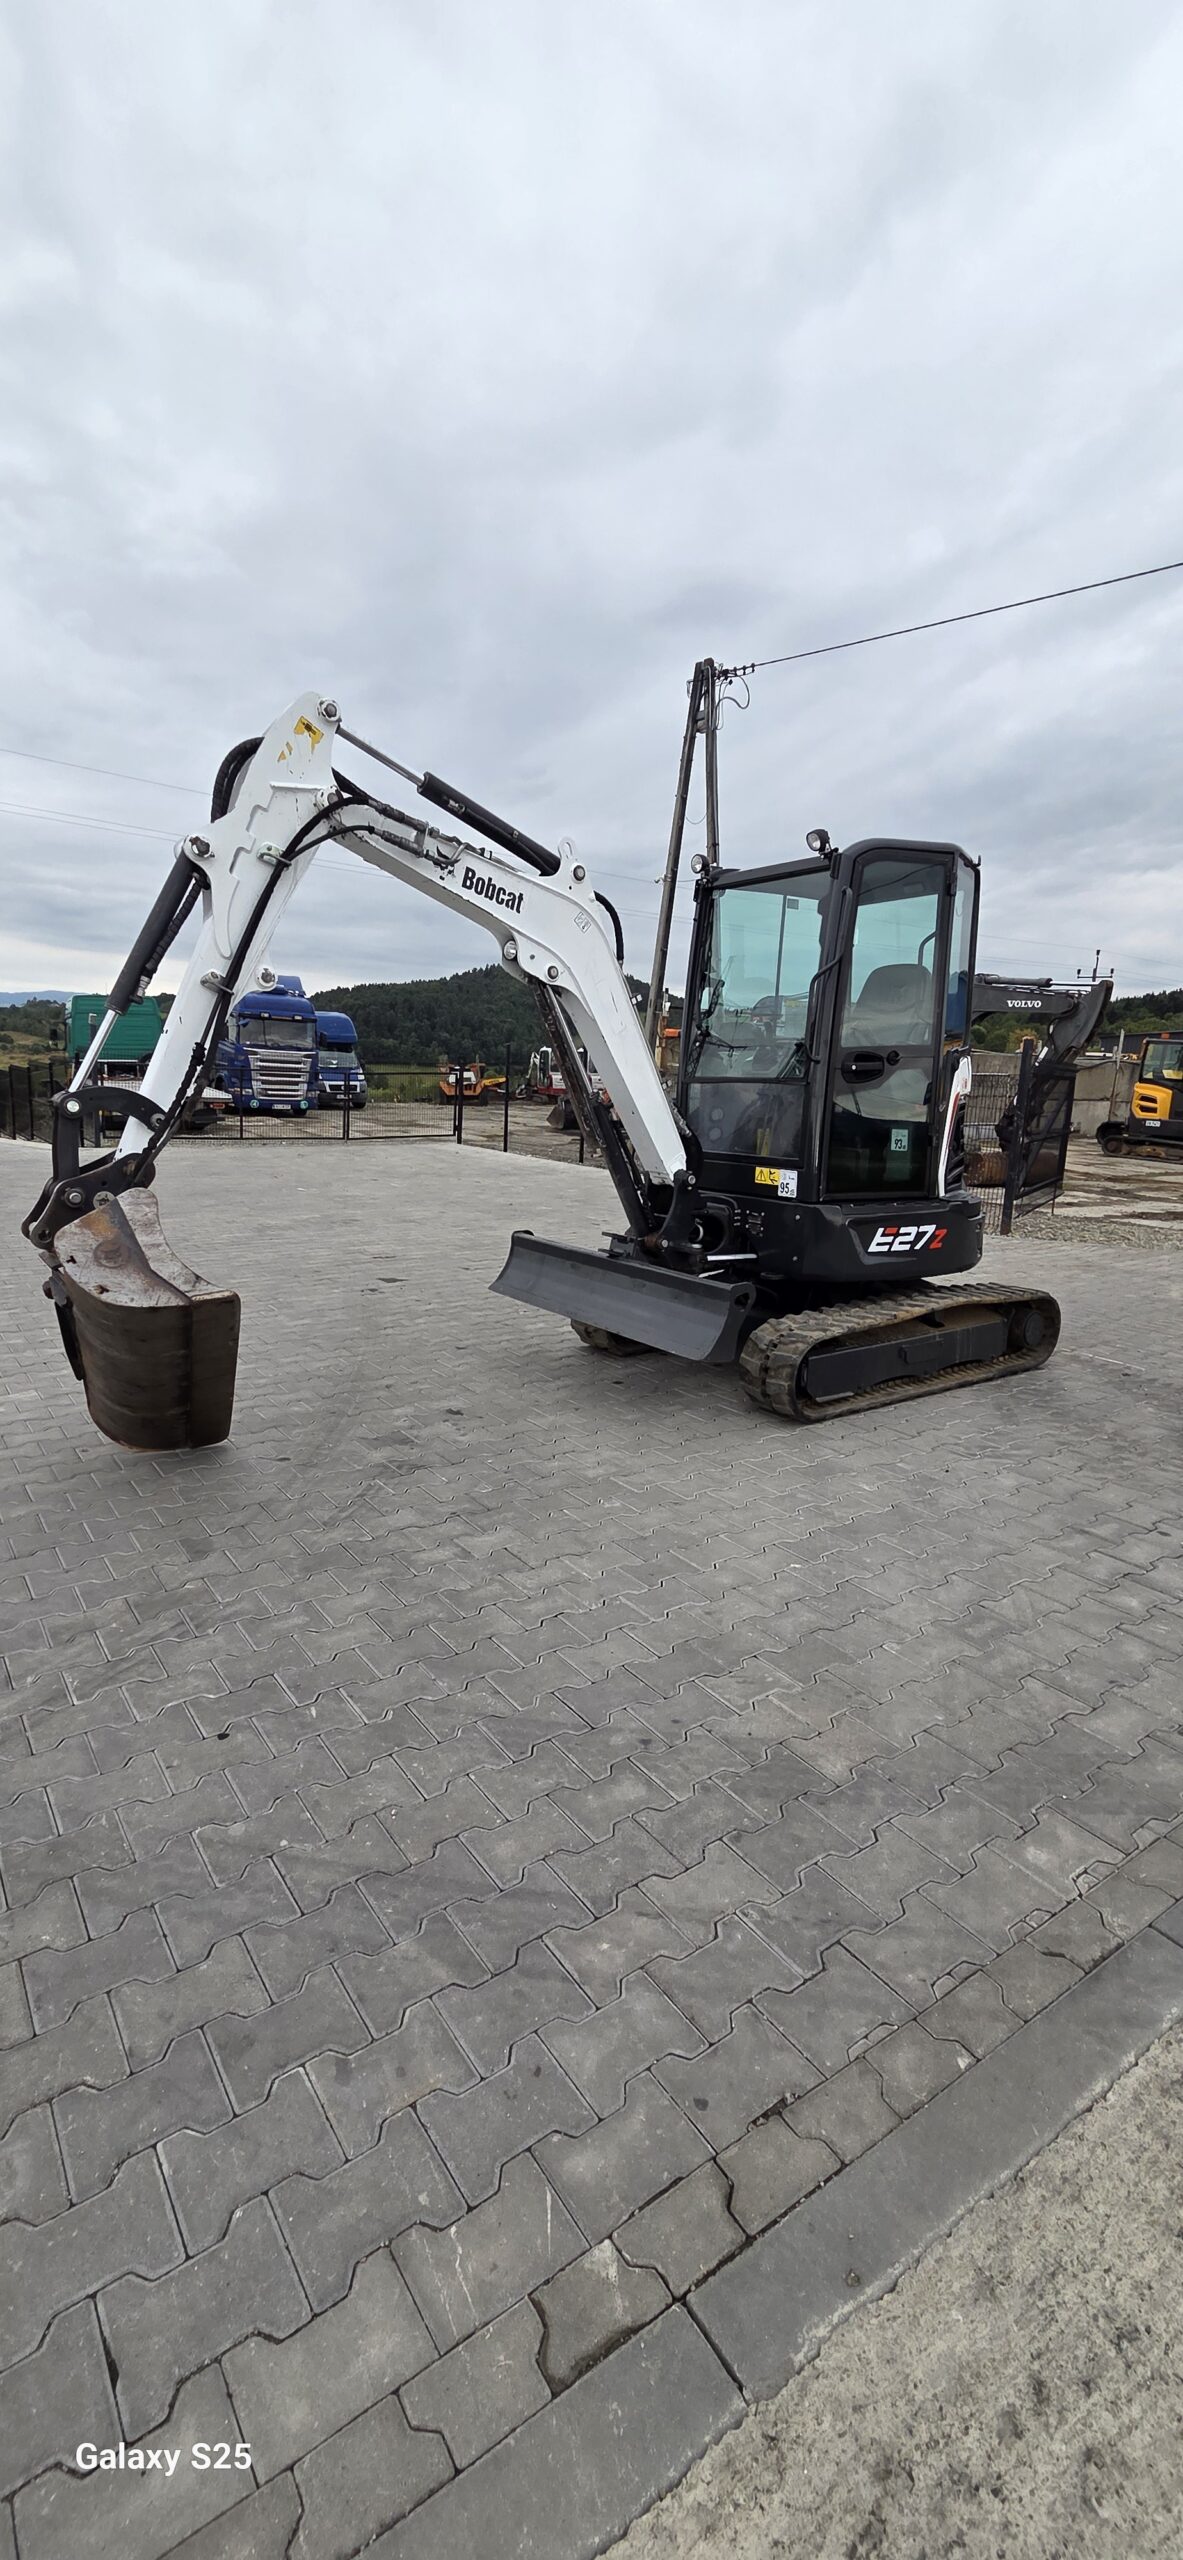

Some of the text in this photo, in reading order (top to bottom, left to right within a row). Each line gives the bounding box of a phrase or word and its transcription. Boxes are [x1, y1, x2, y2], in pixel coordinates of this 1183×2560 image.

[461, 865, 524, 914] Bobcat
[1006, 999, 1042, 1008] VOLVO
[894, 1137, 903, 1149] 93
[780, 1181, 790, 1194] 95
